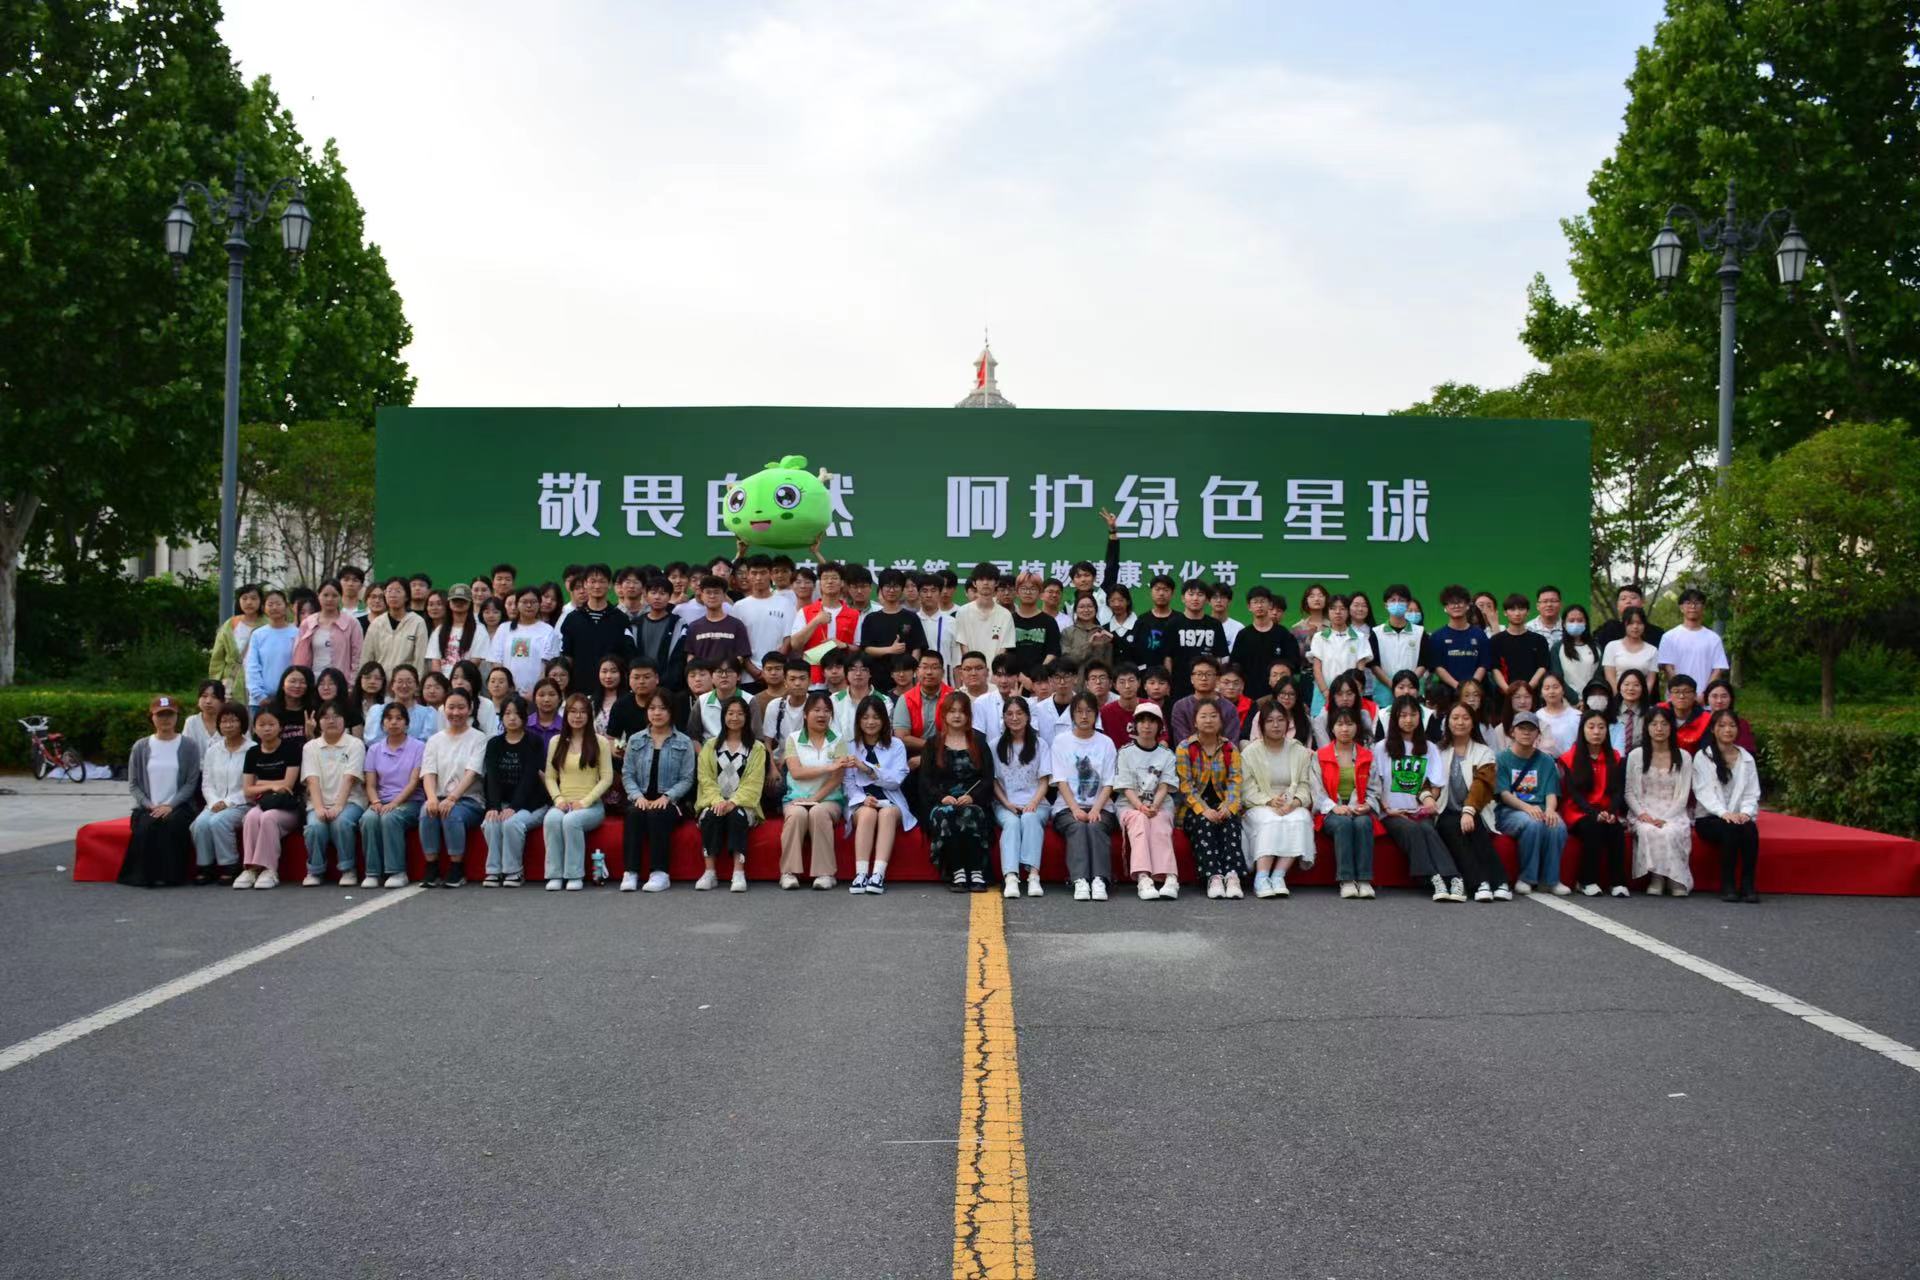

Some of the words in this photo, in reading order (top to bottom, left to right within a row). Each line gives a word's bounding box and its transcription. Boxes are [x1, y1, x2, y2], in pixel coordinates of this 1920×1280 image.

[947, 474, 1430, 543] 呵护绿色星球
[1178, 629, 1215, 647] 1978
